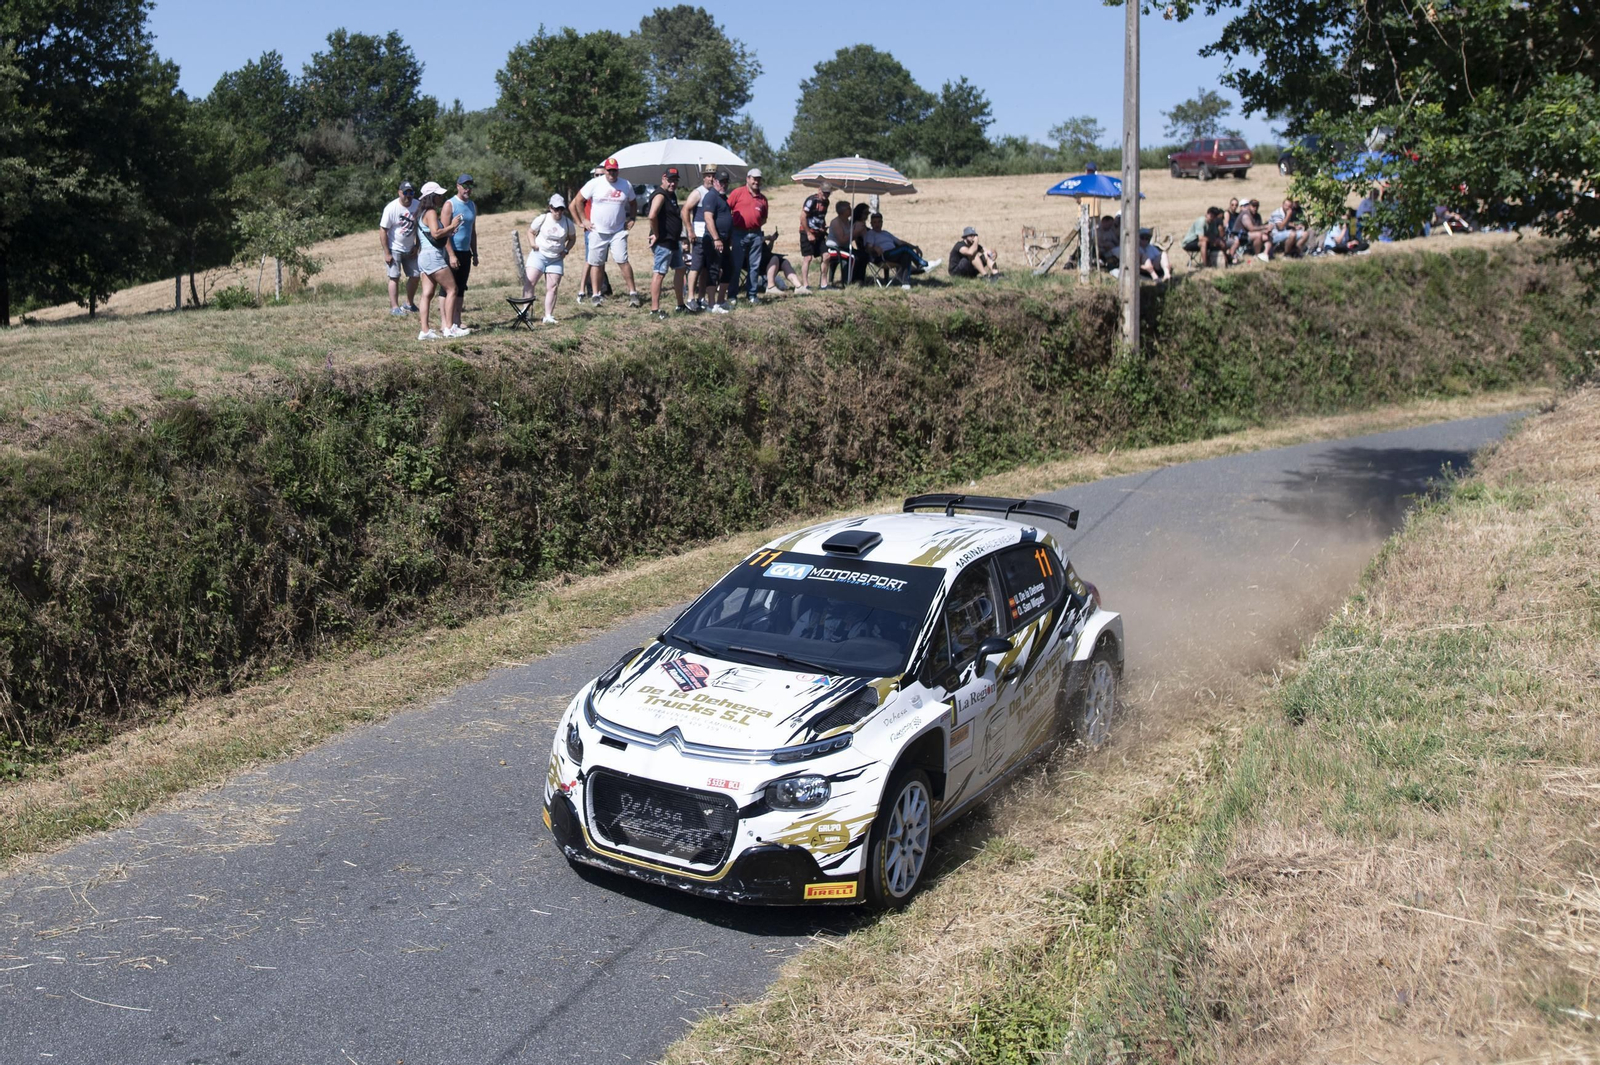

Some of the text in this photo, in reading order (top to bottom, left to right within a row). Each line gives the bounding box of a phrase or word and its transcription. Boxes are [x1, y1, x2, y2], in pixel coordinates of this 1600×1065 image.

[749, 550, 783, 567] 11
[1035, 548, 1053, 578] 11
[811, 567, 908, 589] MOTORSPORT
[1018, 591, 1026, 602] De
[1024, 589, 1031, 599] la
[1028, 582, 1045, 596] Dehesa
[1022, 602, 1032, 613] San
[1030, 593, 1046, 608] Miguel
[637, 685, 774, 719] De la Dehesa
[644, 695, 751, 727] Trucks S.L
[958, 699, 969, 713] La
[883, 708, 908, 727] Dehesa
[620, 793, 683, 822] Dehesa
[818, 823, 841, 833] GRUPO
[807, 884, 854, 896] PIRELLI
